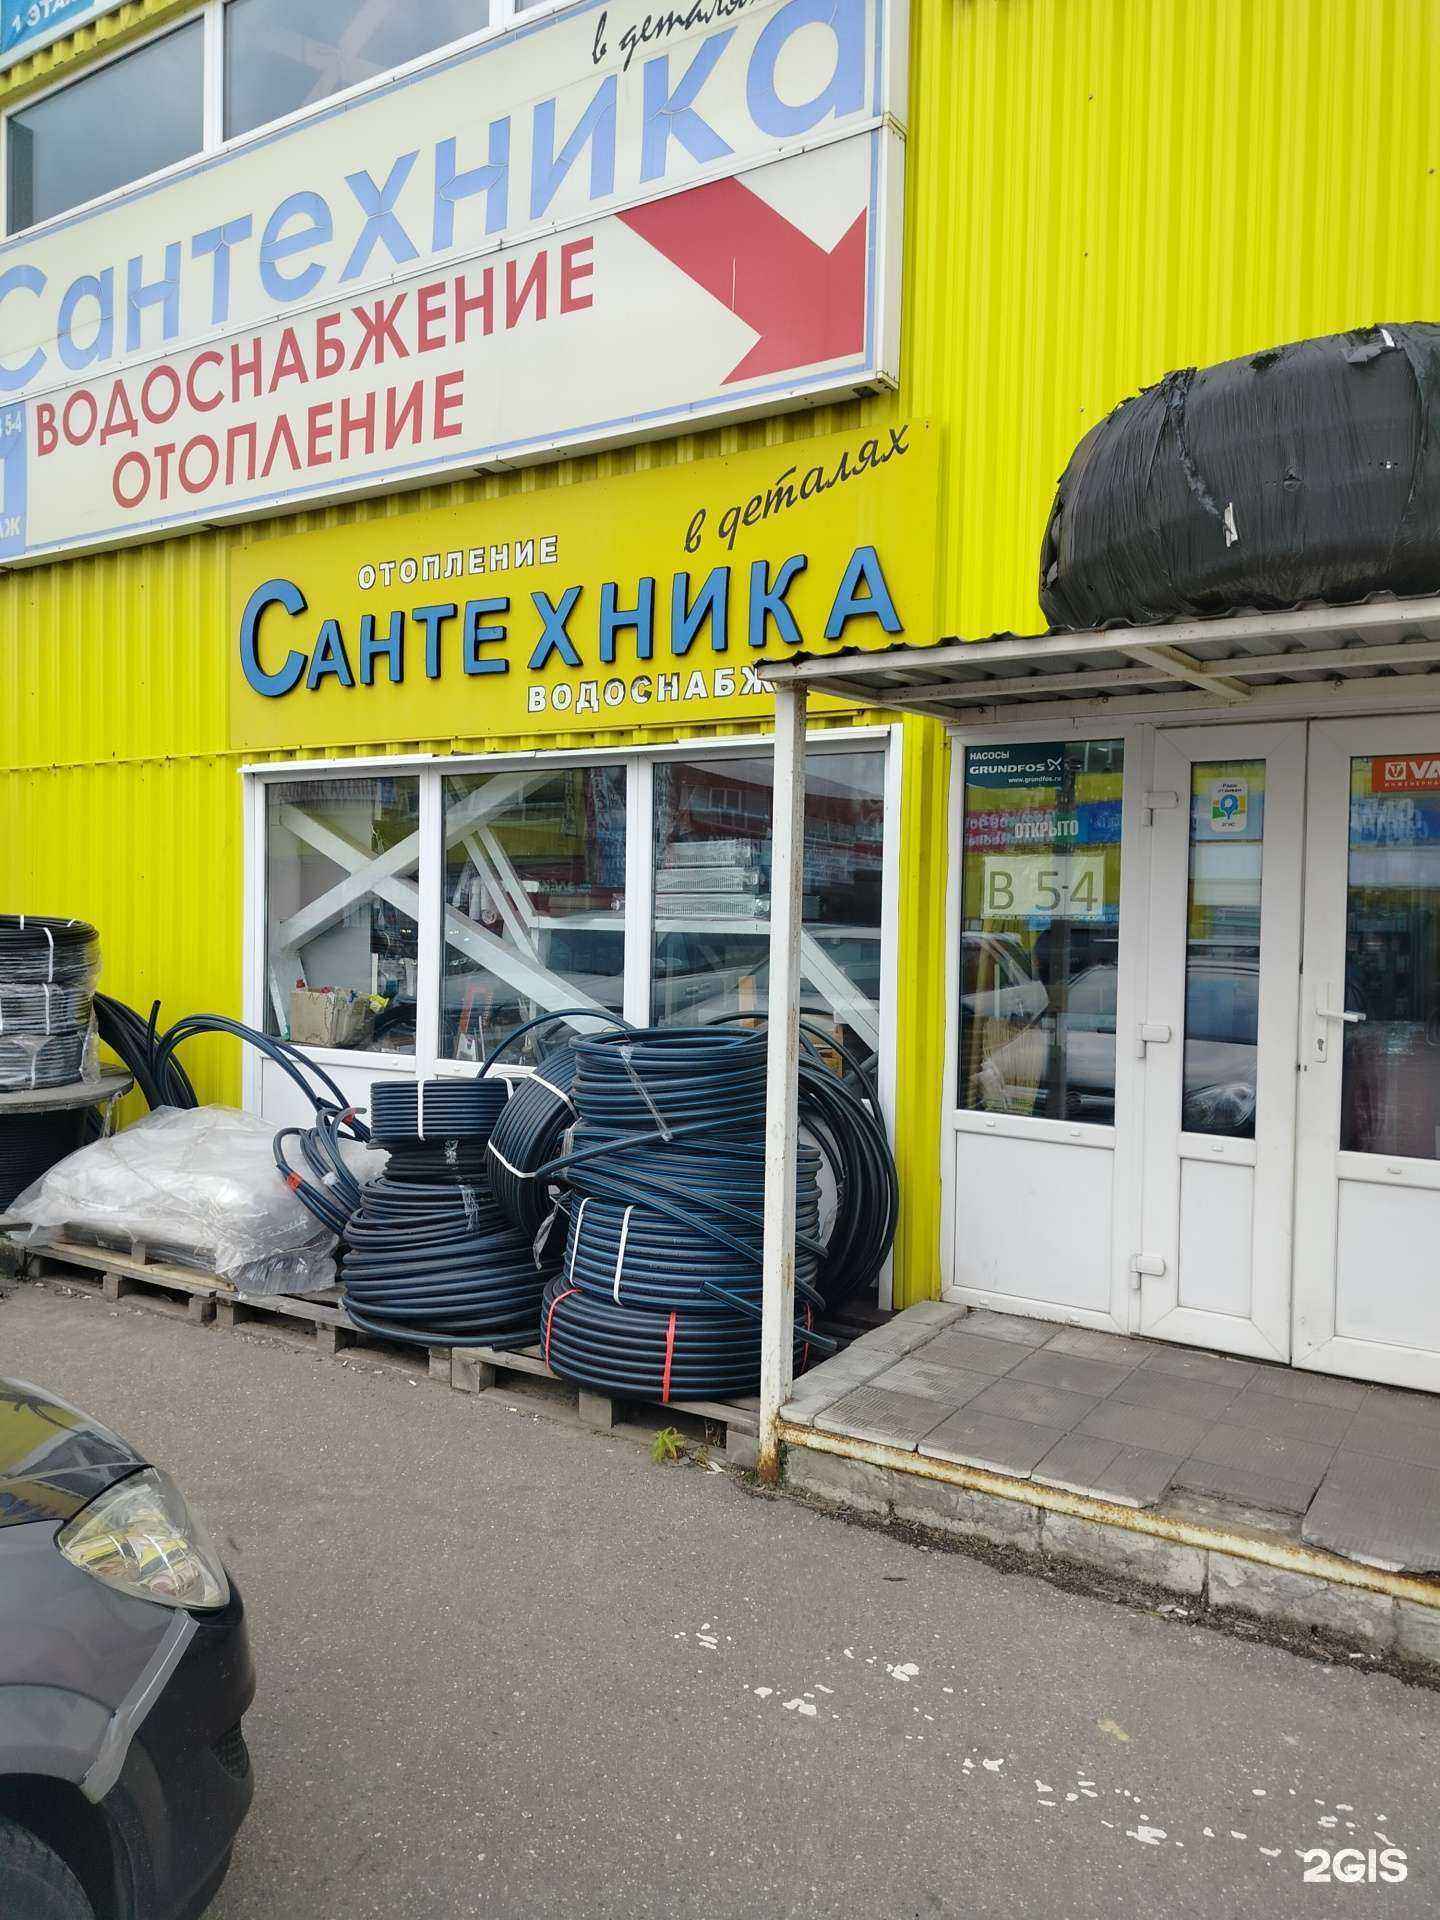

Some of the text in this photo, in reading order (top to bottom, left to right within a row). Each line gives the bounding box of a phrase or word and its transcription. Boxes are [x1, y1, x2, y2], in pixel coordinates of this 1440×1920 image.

[0, 0, 866, 392] Сантехника
[36, 236, 595, 457] ВОДОСНАБЖЕНИЕ
[112, 369, 465, 509] ОТОПЛЕНИЕ
[684, 424, 910, 554] в деталях
[357, 535, 559, 590] ОТОПЛЕНИЕ
[969, 751, 1010, 760] НАСОСЫ
[969, 763, 1045, 775] GRUNDFOS
[1014, 820, 1079, 838] ОТКРЫТО
[989, 870, 1099, 912] В 5-4
